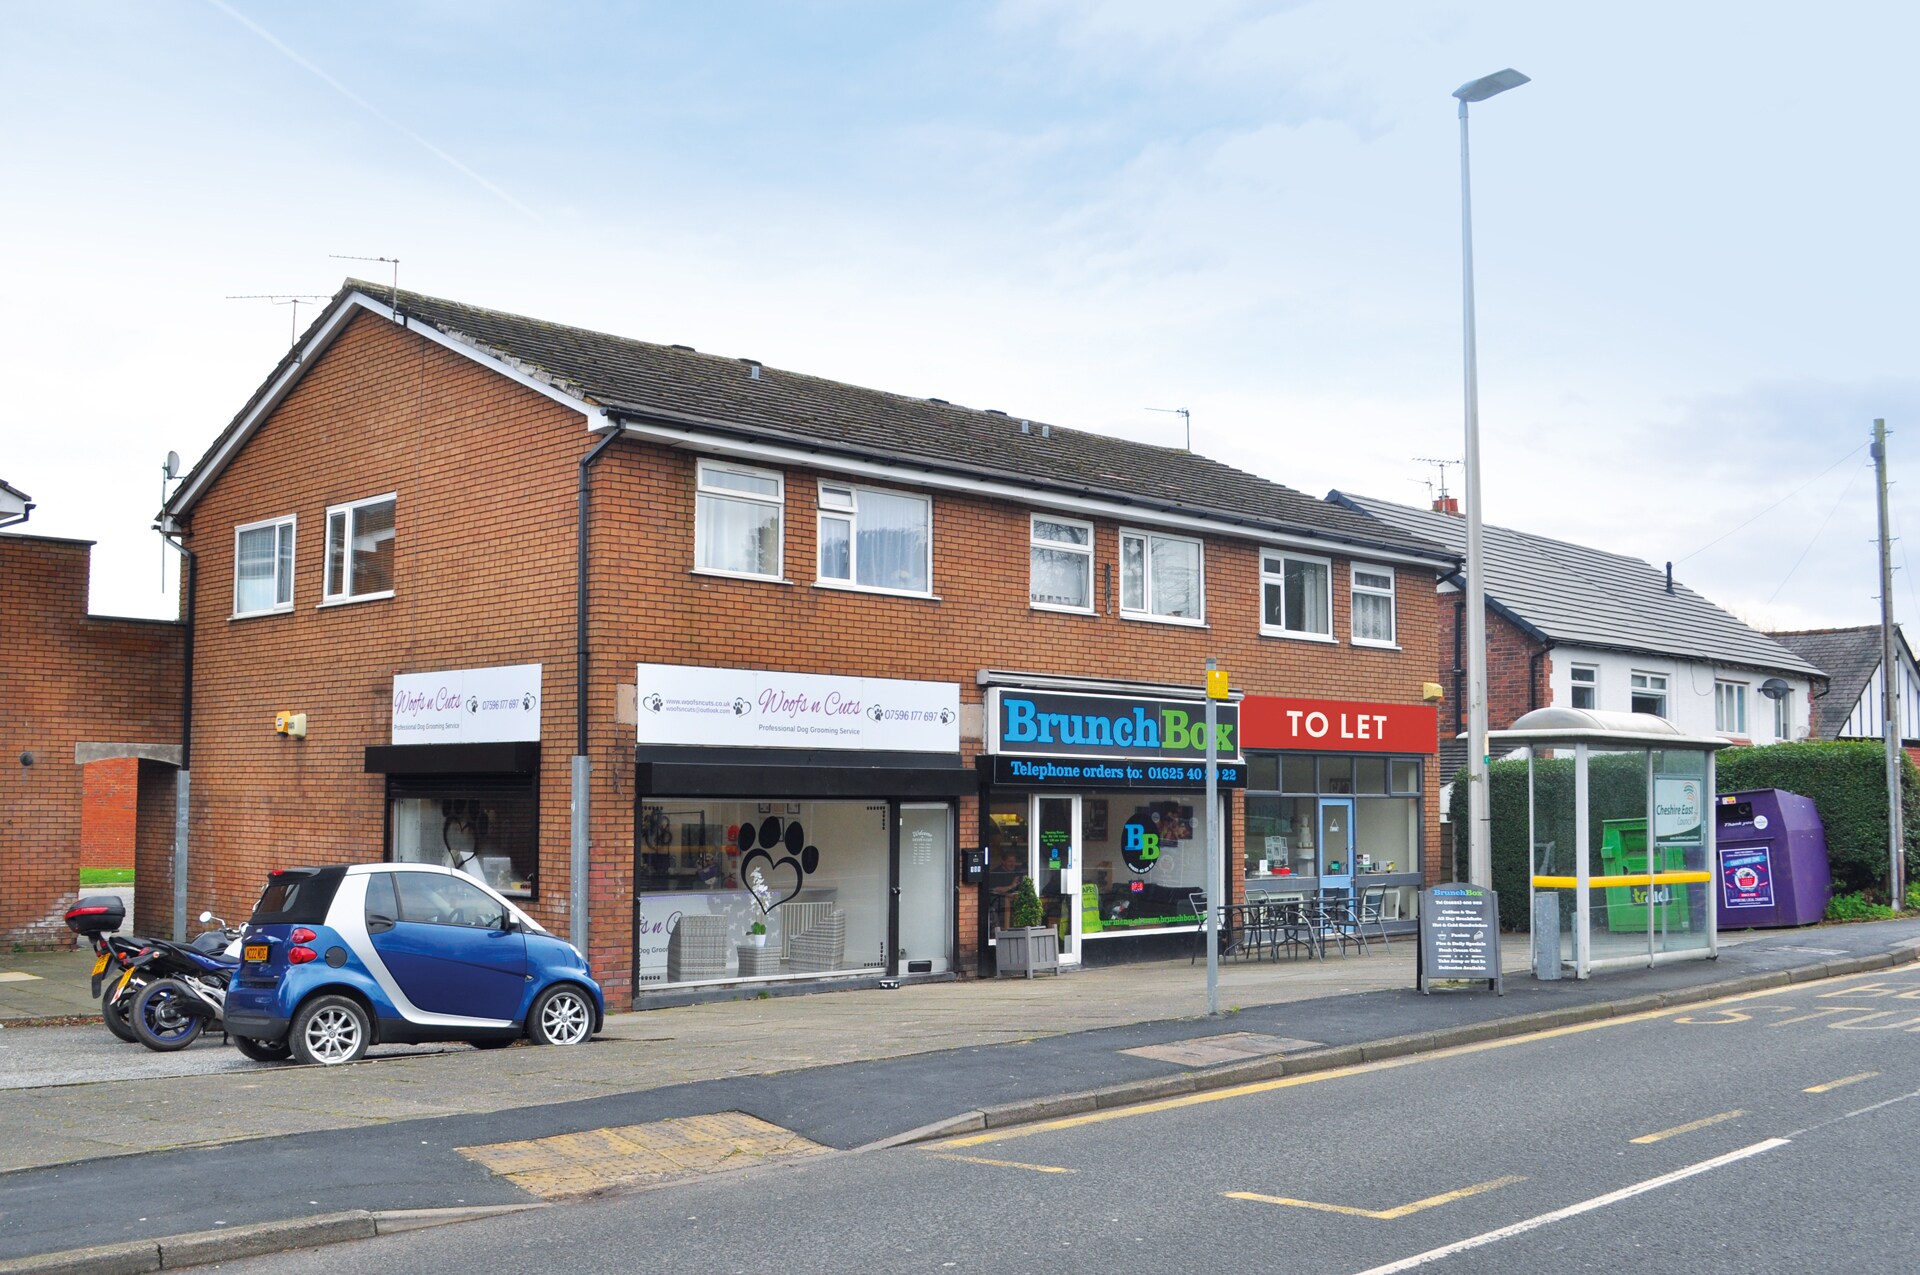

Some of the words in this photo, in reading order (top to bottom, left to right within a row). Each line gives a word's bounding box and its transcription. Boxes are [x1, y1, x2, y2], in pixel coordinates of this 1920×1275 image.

[394, 690, 425, 717] Woofs
[427, 698, 434, 710] n
[436, 686, 462, 711] Cuts
[482, 700, 499, 710] 07596
[500, 700, 508, 710] 177
[509, 698, 520, 710] 697
[666, 698, 730, 707] www.woofsncuts.co.uk
[758, 688, 808, 718] Woofs
[811, 701, 821, 713] n
[824, 692, 862, 716] Cuts
[666, 706, 730, 714] woofsncuts@outlook.com
[884, 710, 910, 720] 07596
[911, 710, 922, 721] 177
[924, 712, 938, 722] 697
[758, 724, 795, 732] Professional
[797, 726, 808, 734] Dog
[810, 726, 838, 736] Grooming
[1003, 698, 1234, 752] BrunchBox
[1286, 710, 1328, 738] TO
[1340, 713, 1388, 740] LET
[1010, 760, 1080, 780] Telephone
[1083, 764, 1124, 778] orders
[1126, 766, 1142, 778] to:
[1148, 766, 1184, 780] 01625
[1187, 768, 1202, 780] 40
[1222, 768, 1236, 781] 22
[1657, 804, 1681, 815] Cheshire
[1682, 804, 1694, 814] East
